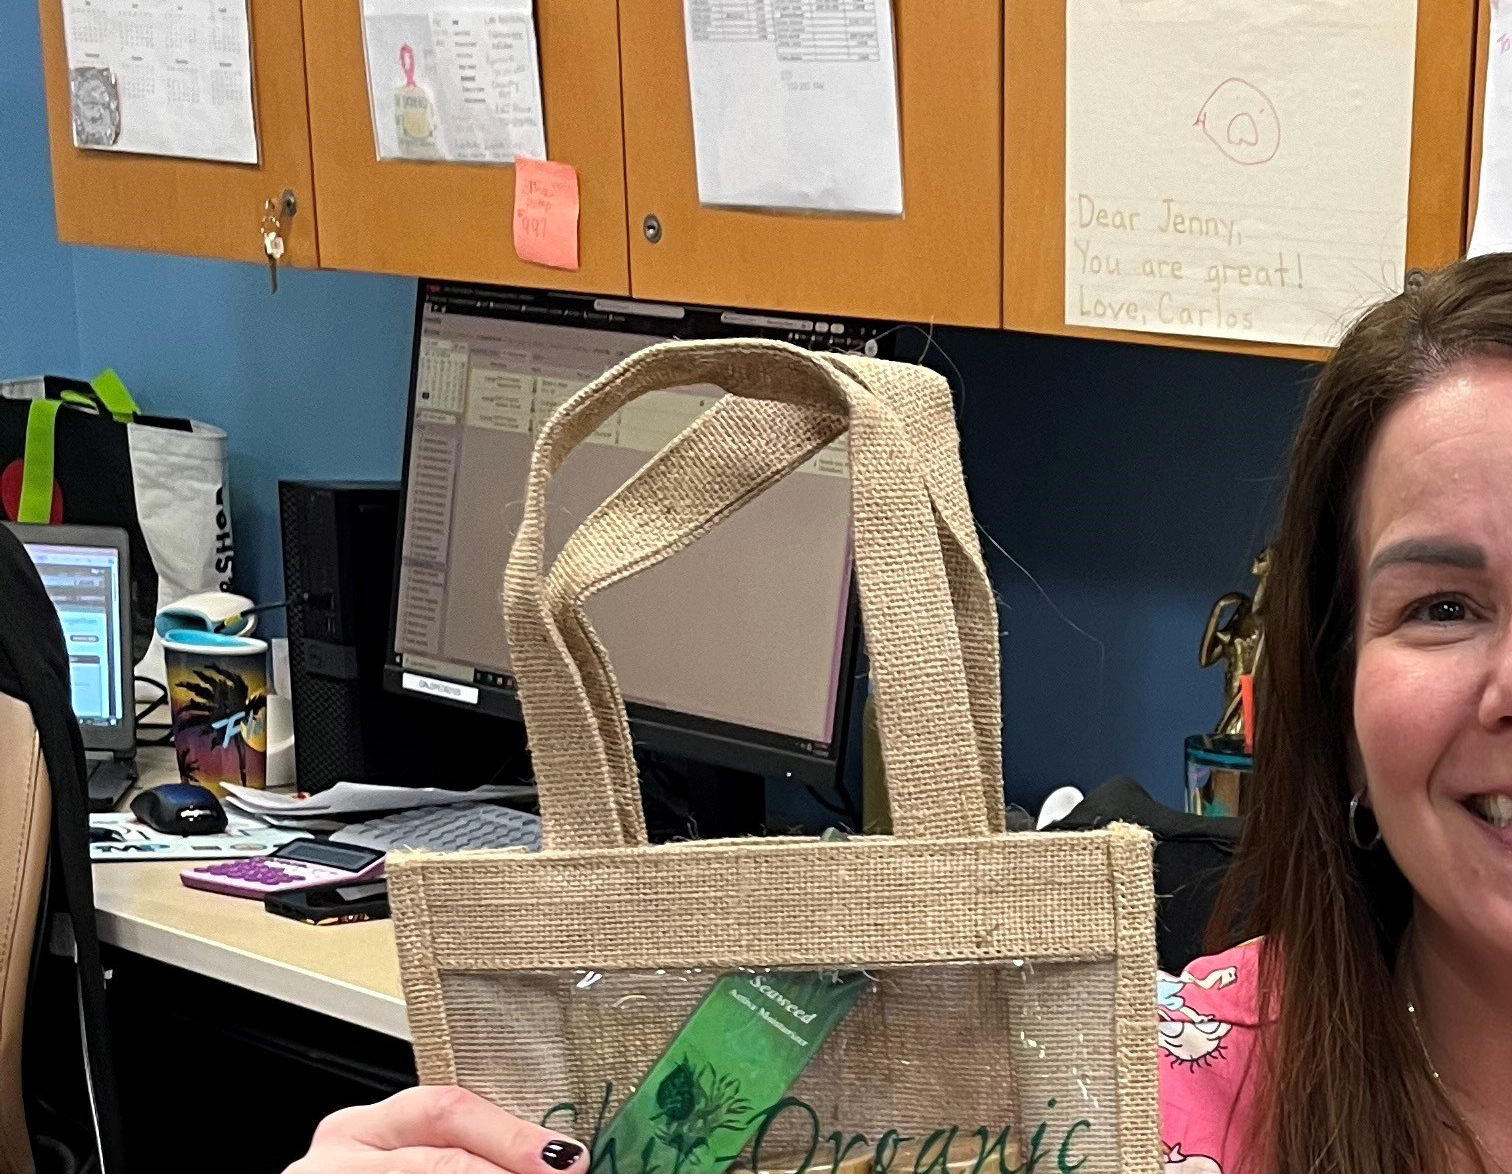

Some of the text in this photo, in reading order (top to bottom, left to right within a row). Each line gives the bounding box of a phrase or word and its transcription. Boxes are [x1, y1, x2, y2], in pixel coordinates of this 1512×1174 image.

[1078, 193, 1242, 246] Dear Jenny,
[1073, 239, 1303, 292] You are great!
[1078, 285, 1252, 330] Love, Carlos
[749, 975, 817, 1025] Seaweed
